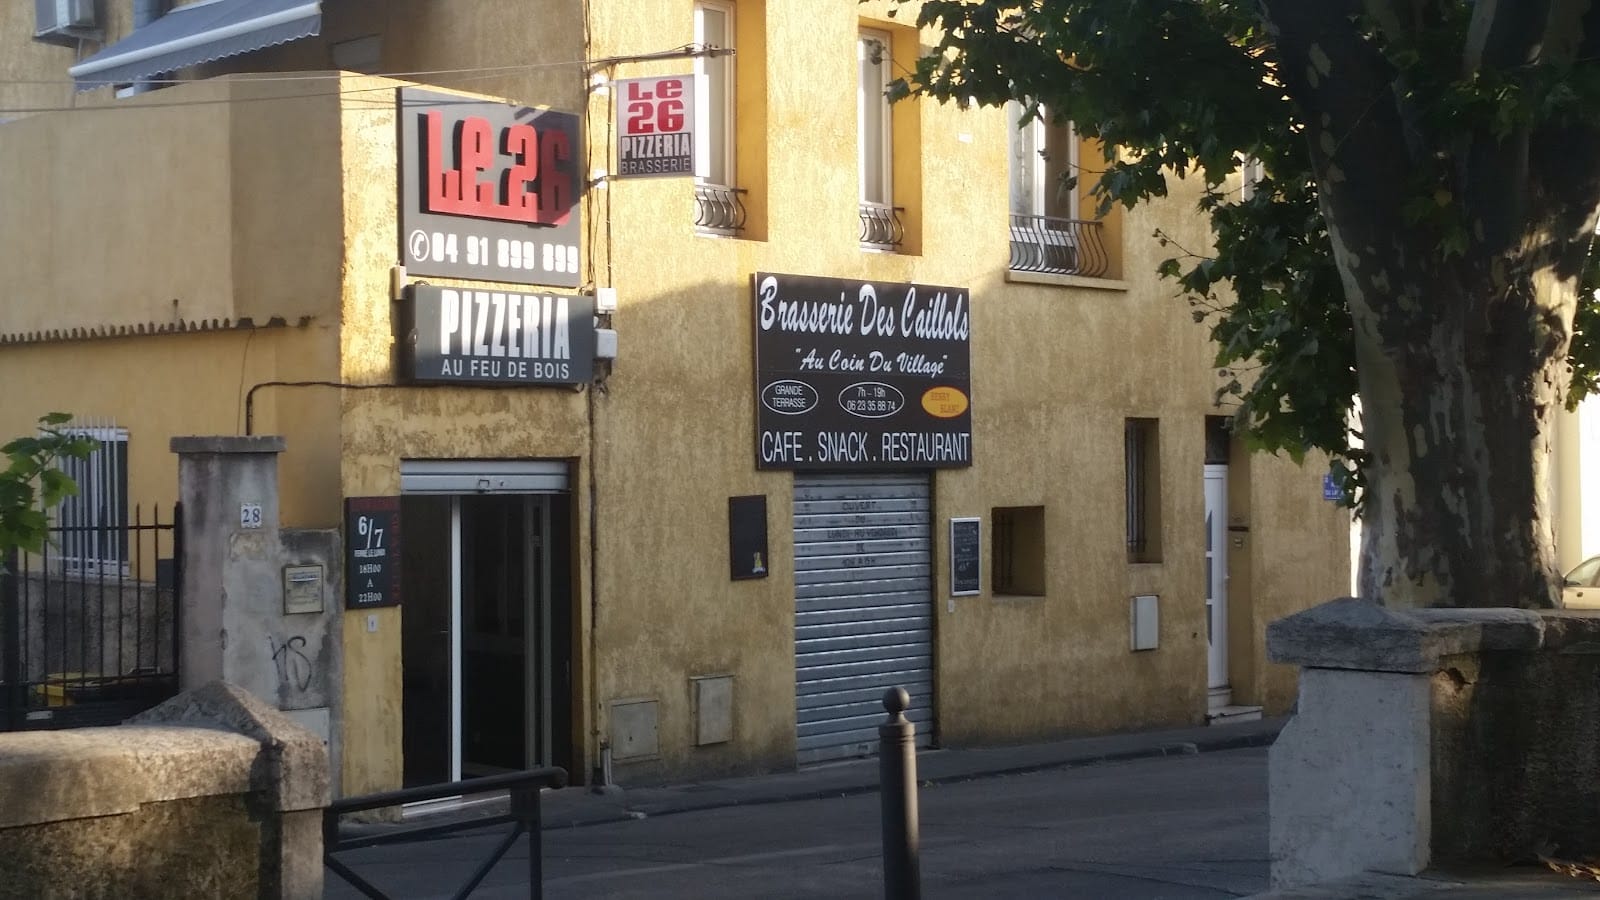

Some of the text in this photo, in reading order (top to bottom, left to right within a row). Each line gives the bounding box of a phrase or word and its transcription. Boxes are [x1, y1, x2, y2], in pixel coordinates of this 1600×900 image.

[627, 80, 683, 101] Le
[627, 100, 684, 134] 26
[621, 133, 691, 159] PIZZERIA
[505, 124, 572, 225] 26
[621, 158, 690, 174] BRASSERIE
[431, 232, 458, 263] 04
[466, 236, 489, 266] 91
[760, 276, 969, 341] Brasserie Des Caillols
[440, 289, 571, 360] PIZZERIA
[441, 359, 570, 379] AU FEU DE BOIS
[828, 349, 865, 372] Coin
[869, 350, 892, 373] Du
[775, 385, 803, 396] GRANDE
[857, 387, 866, 398] 7h
[874, 387, 886, 398] 19h
[772, 397, 806, 408] TERRASSE
[847, 400, 896, 411] 06 23 35 88 74
[762, 431, 803, 463] CAFE
[817, 431, 869, 463] SNACK
[882, 432, 970, 462] RESTAURANT
[242, 508, 261, 524] 28
[367, 578, 374, 588] A
[358, 592, 382, 603] 22H00
